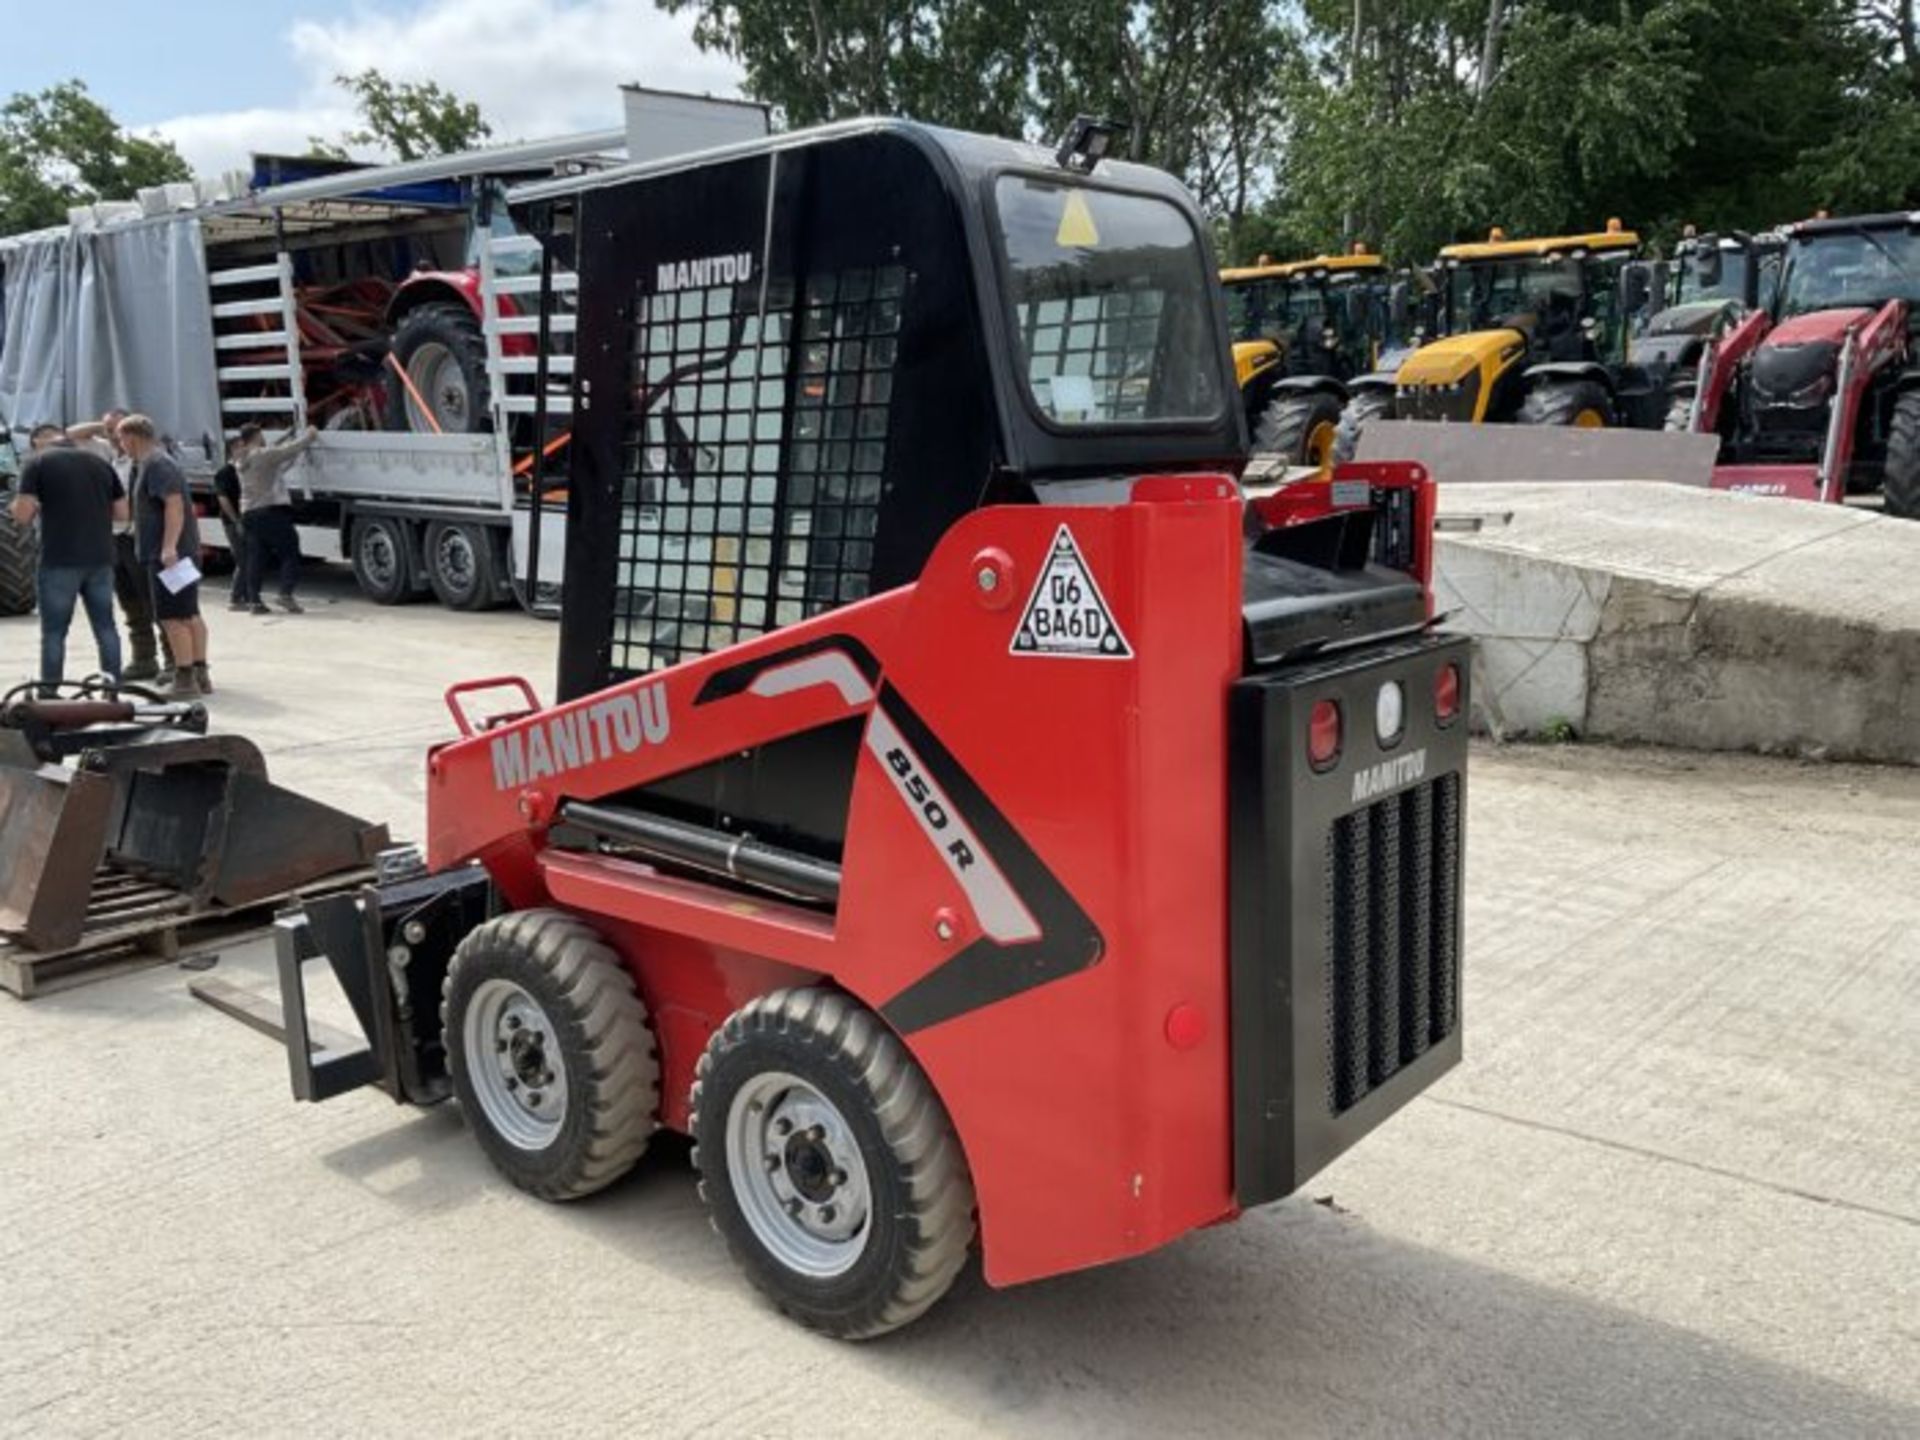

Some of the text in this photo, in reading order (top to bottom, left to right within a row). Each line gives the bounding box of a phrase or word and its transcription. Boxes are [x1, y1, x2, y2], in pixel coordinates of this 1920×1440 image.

[657, 252, 752, 292] MANITOU
[490, 681, 670, 791] MANITOU
[1351, 748, 1427, 804] MANITOU
[886, 748, 975, 872] 850 R
